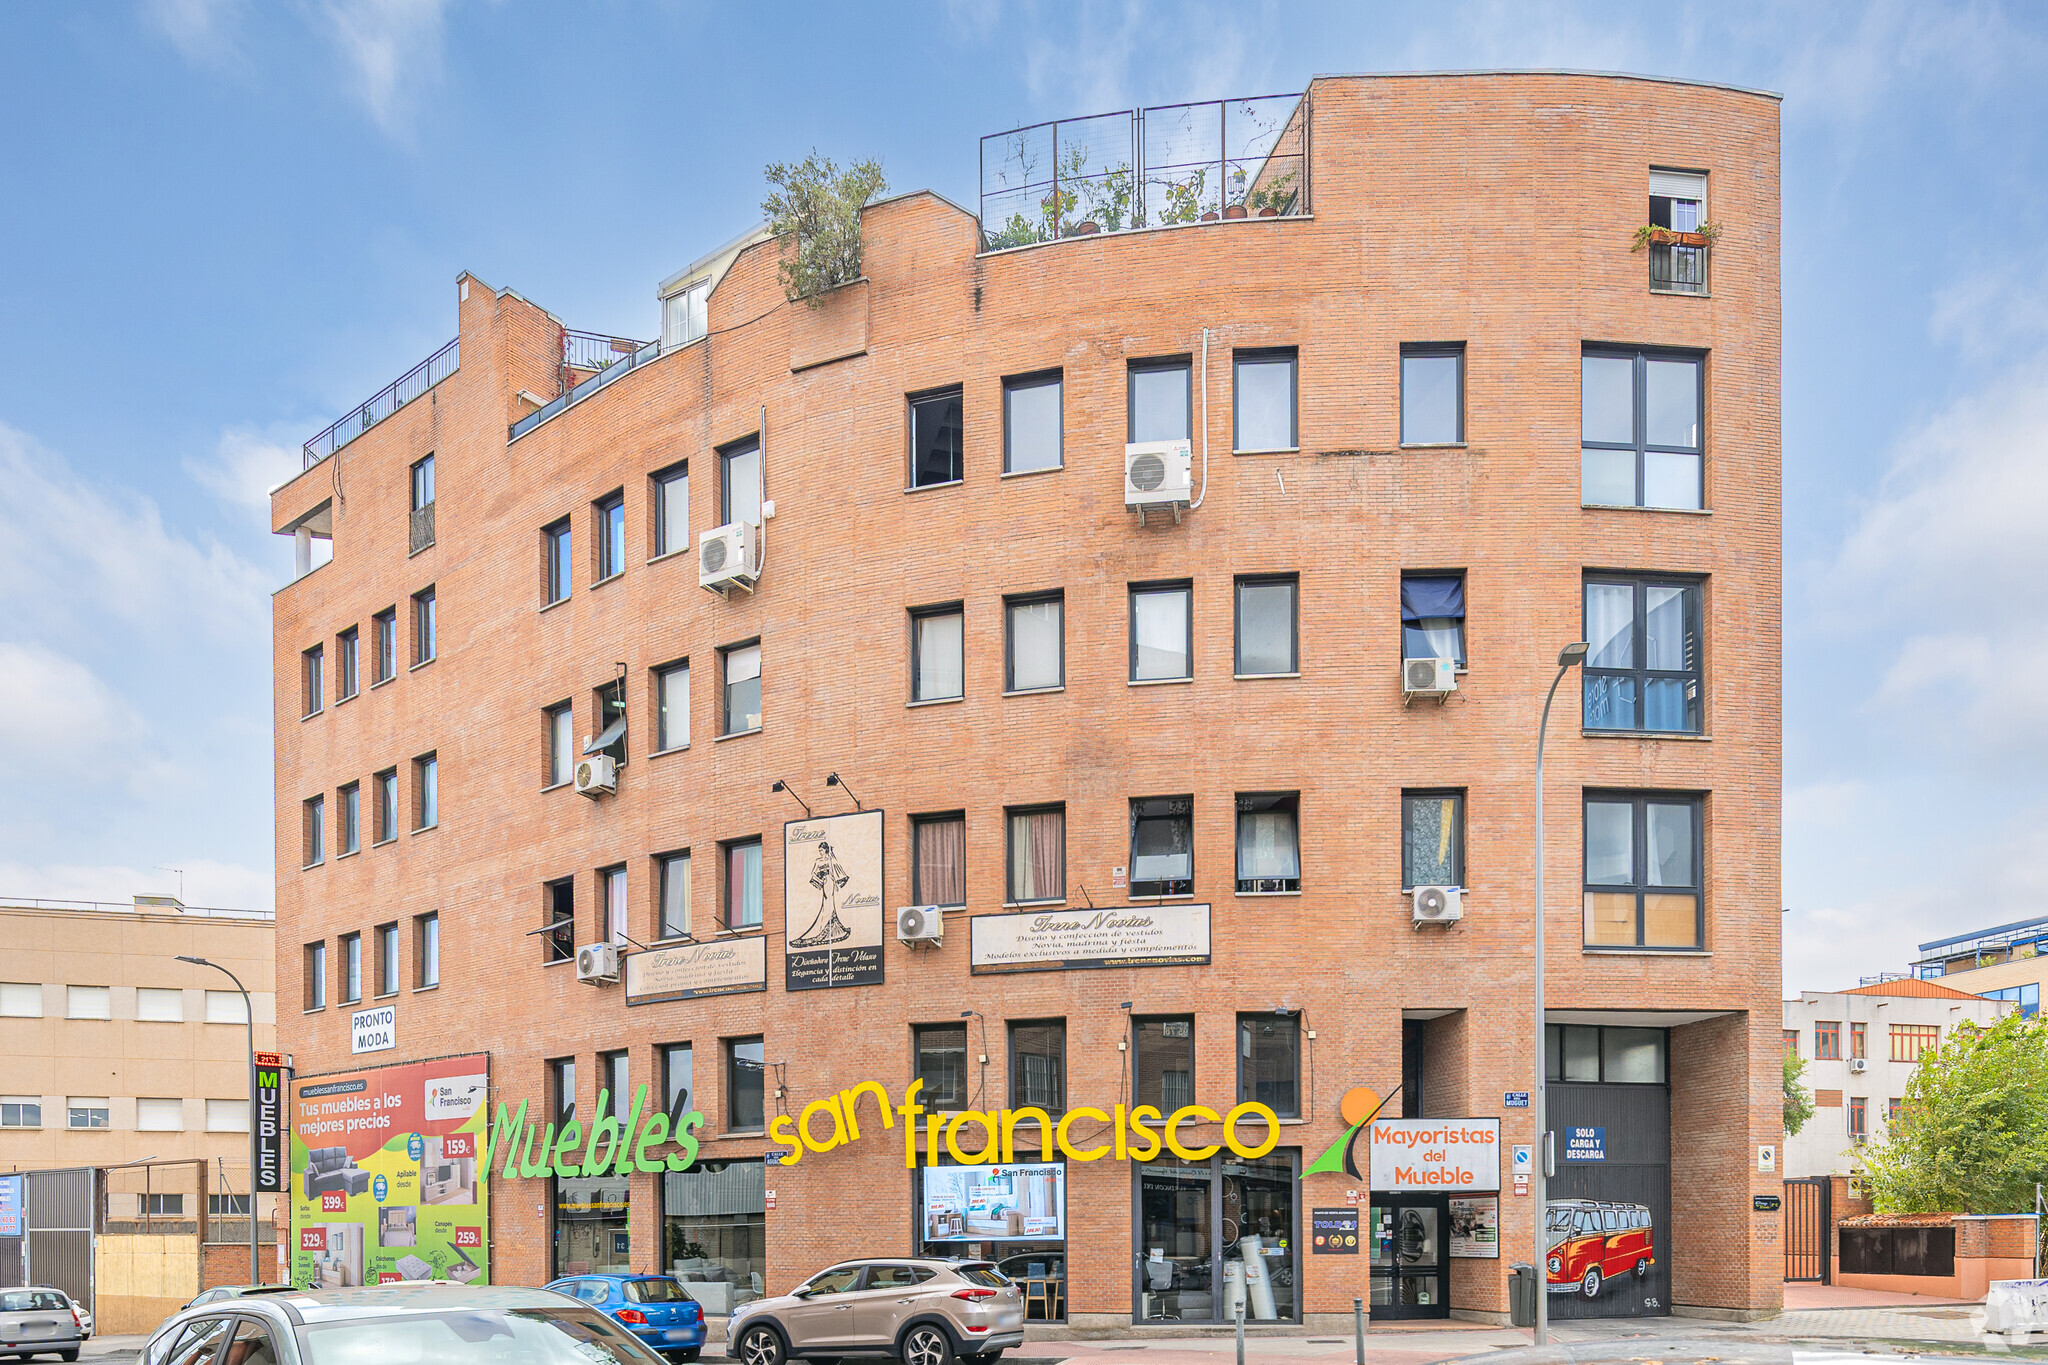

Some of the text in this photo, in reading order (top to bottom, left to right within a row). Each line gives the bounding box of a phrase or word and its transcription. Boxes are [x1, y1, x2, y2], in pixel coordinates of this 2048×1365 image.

[1030, 911, 1154, 933] Irene Novias
[1111, 929, 1122, 937] de
[1125, 928, 1163, 936] vestidos
[1066, 938, 1108, 946] madrina
[1119, 938, 1146, 946] fiesta
[851, 950, 877, 963] Velasco
[984, 952, 1021, 960] Modelos
[1023, 949, 1071, 957] exclusivos
[1082, 945, 1118, 954] medida
[1129, 943, 1198, 953] complementos
[791, 968, 823, 978] Elegancia
[812, 973, 855, 983] cada detalle
[354, 1010, 393, 1030] PRONTO
[358, 1031, 389, 1049] MODA
[302, 1082, 364, 1097] mueblessanfrancisco.es
[440, 1087, 452, 1097] San
[299, 1092, 402, 1117] Tus muebles a los
[440, 1097, 472, 1108] Francisco
[258, 1071, 278, 1187] MUEBLES
[300, 1112, 391, 1137] mejores precios
[769, 1078, 1281, 1169] san francisco
[480, 1083, 704, 1184] Muebles
[1374, 1125, 1495, 1149] Mayoristas
[1575, 1128, 1595, 1138] SOLO
[446, 1139, 471, 1155] 159€
[1570, 1139, 1601, 1148] CARGA Y
[1423, 1149, 1446, 1162] del
[1566, 1149, 1605, 1159] DESCARGA
[396, 1170, 417, 1178] Apilable
[1001, 1168, 1062, 1177] San Francisco
[1395, 1166, 1474, 1185] Mueble
[323, 1196, 345, 1209] 399€
[302, 1233, 324, 1247] 329€
[457, 1231, 479, 1244] 259€
